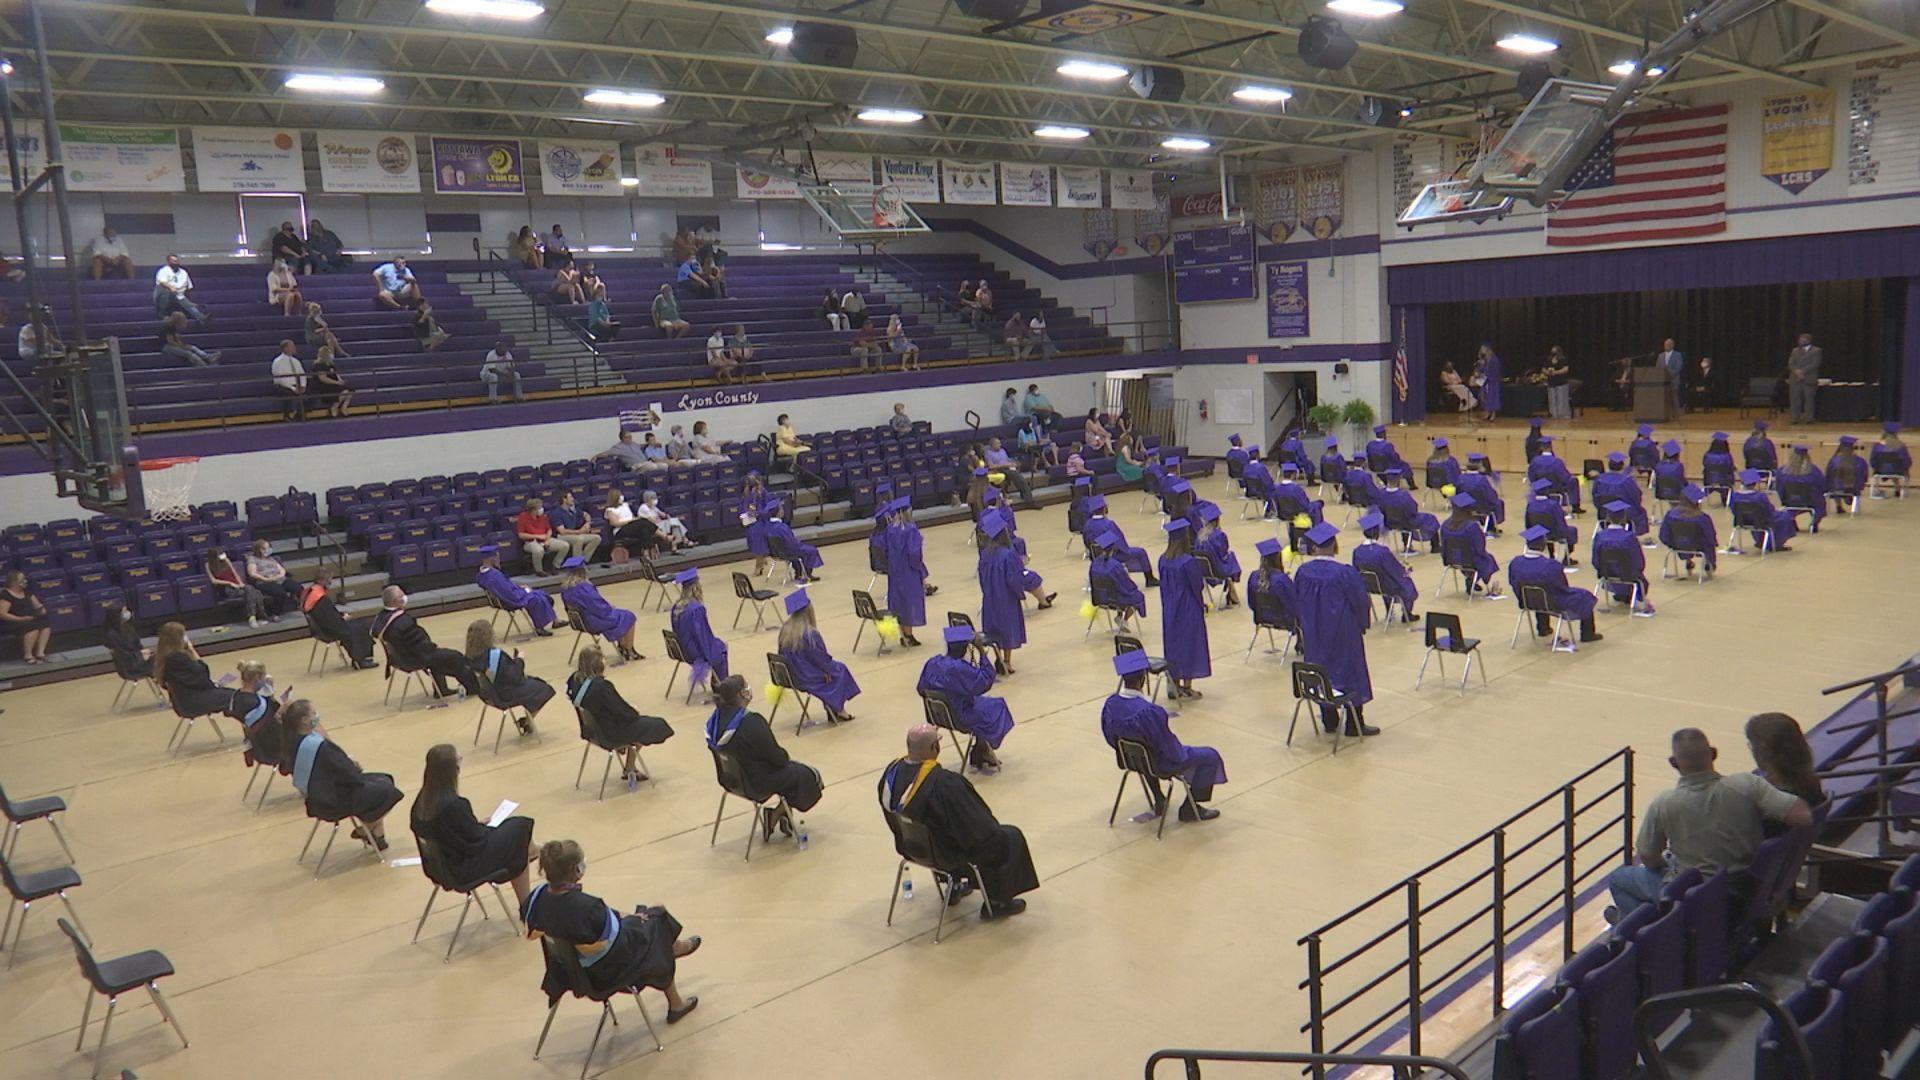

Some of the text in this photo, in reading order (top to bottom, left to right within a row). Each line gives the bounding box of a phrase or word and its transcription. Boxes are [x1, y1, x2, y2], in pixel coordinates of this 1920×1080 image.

[1764, 103, 1809, 117] LYONS
[883, 159, 914, 175] Venture
[1781, 172, 1813, 185] LCHS
[1230, 226, 1251, 235] GUEST
[678, 390, 760, 411] Lyon County
